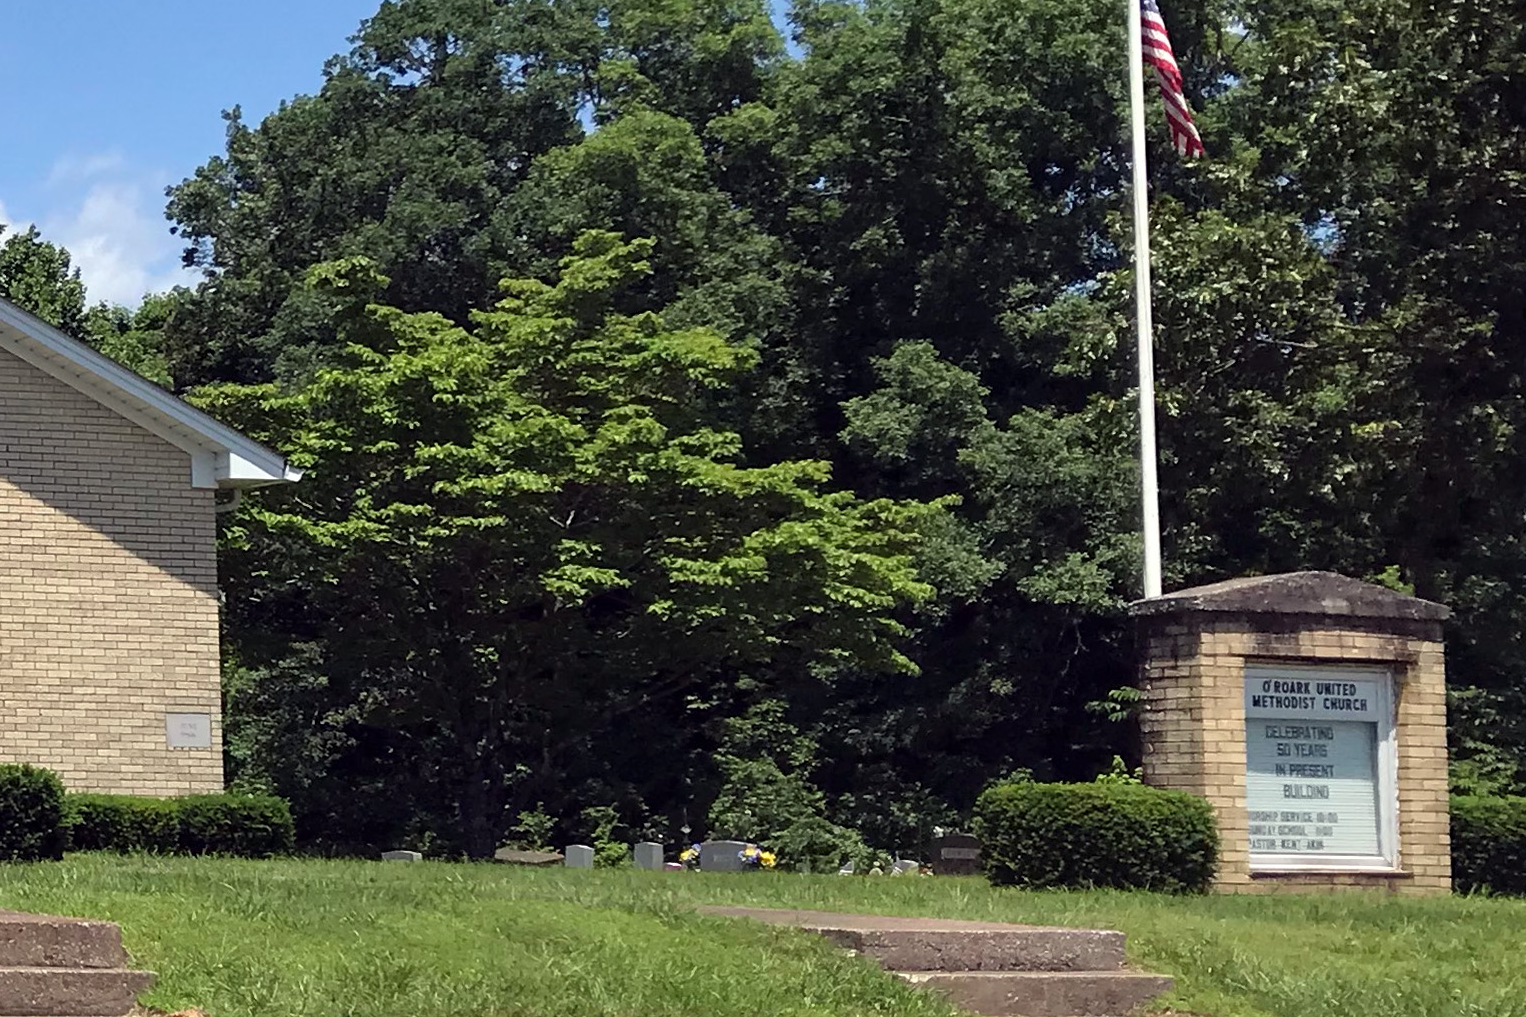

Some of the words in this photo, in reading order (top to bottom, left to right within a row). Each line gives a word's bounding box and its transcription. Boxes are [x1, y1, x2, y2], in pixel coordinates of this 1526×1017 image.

[1262, 679, 1311, 695] O'ROARK
[1316, 682, 1357, 696] UNITED
[1252, 694, 1316, 709] METHODIST
[1323, 697, 1368, 712] CHURCH
[1265, 725, 1334, 741] CELEBRATING
[1277, 742, 1291, 757] 50
[1294, 742, 1328, 758] YEARS
[1275, 763, 1286, 777] IN
[1289, 763, 1334, 779] PRESENT
[1283, 784, 1330, 800] BUILDING
[1280, 811, 1314, 823] SERVICE
